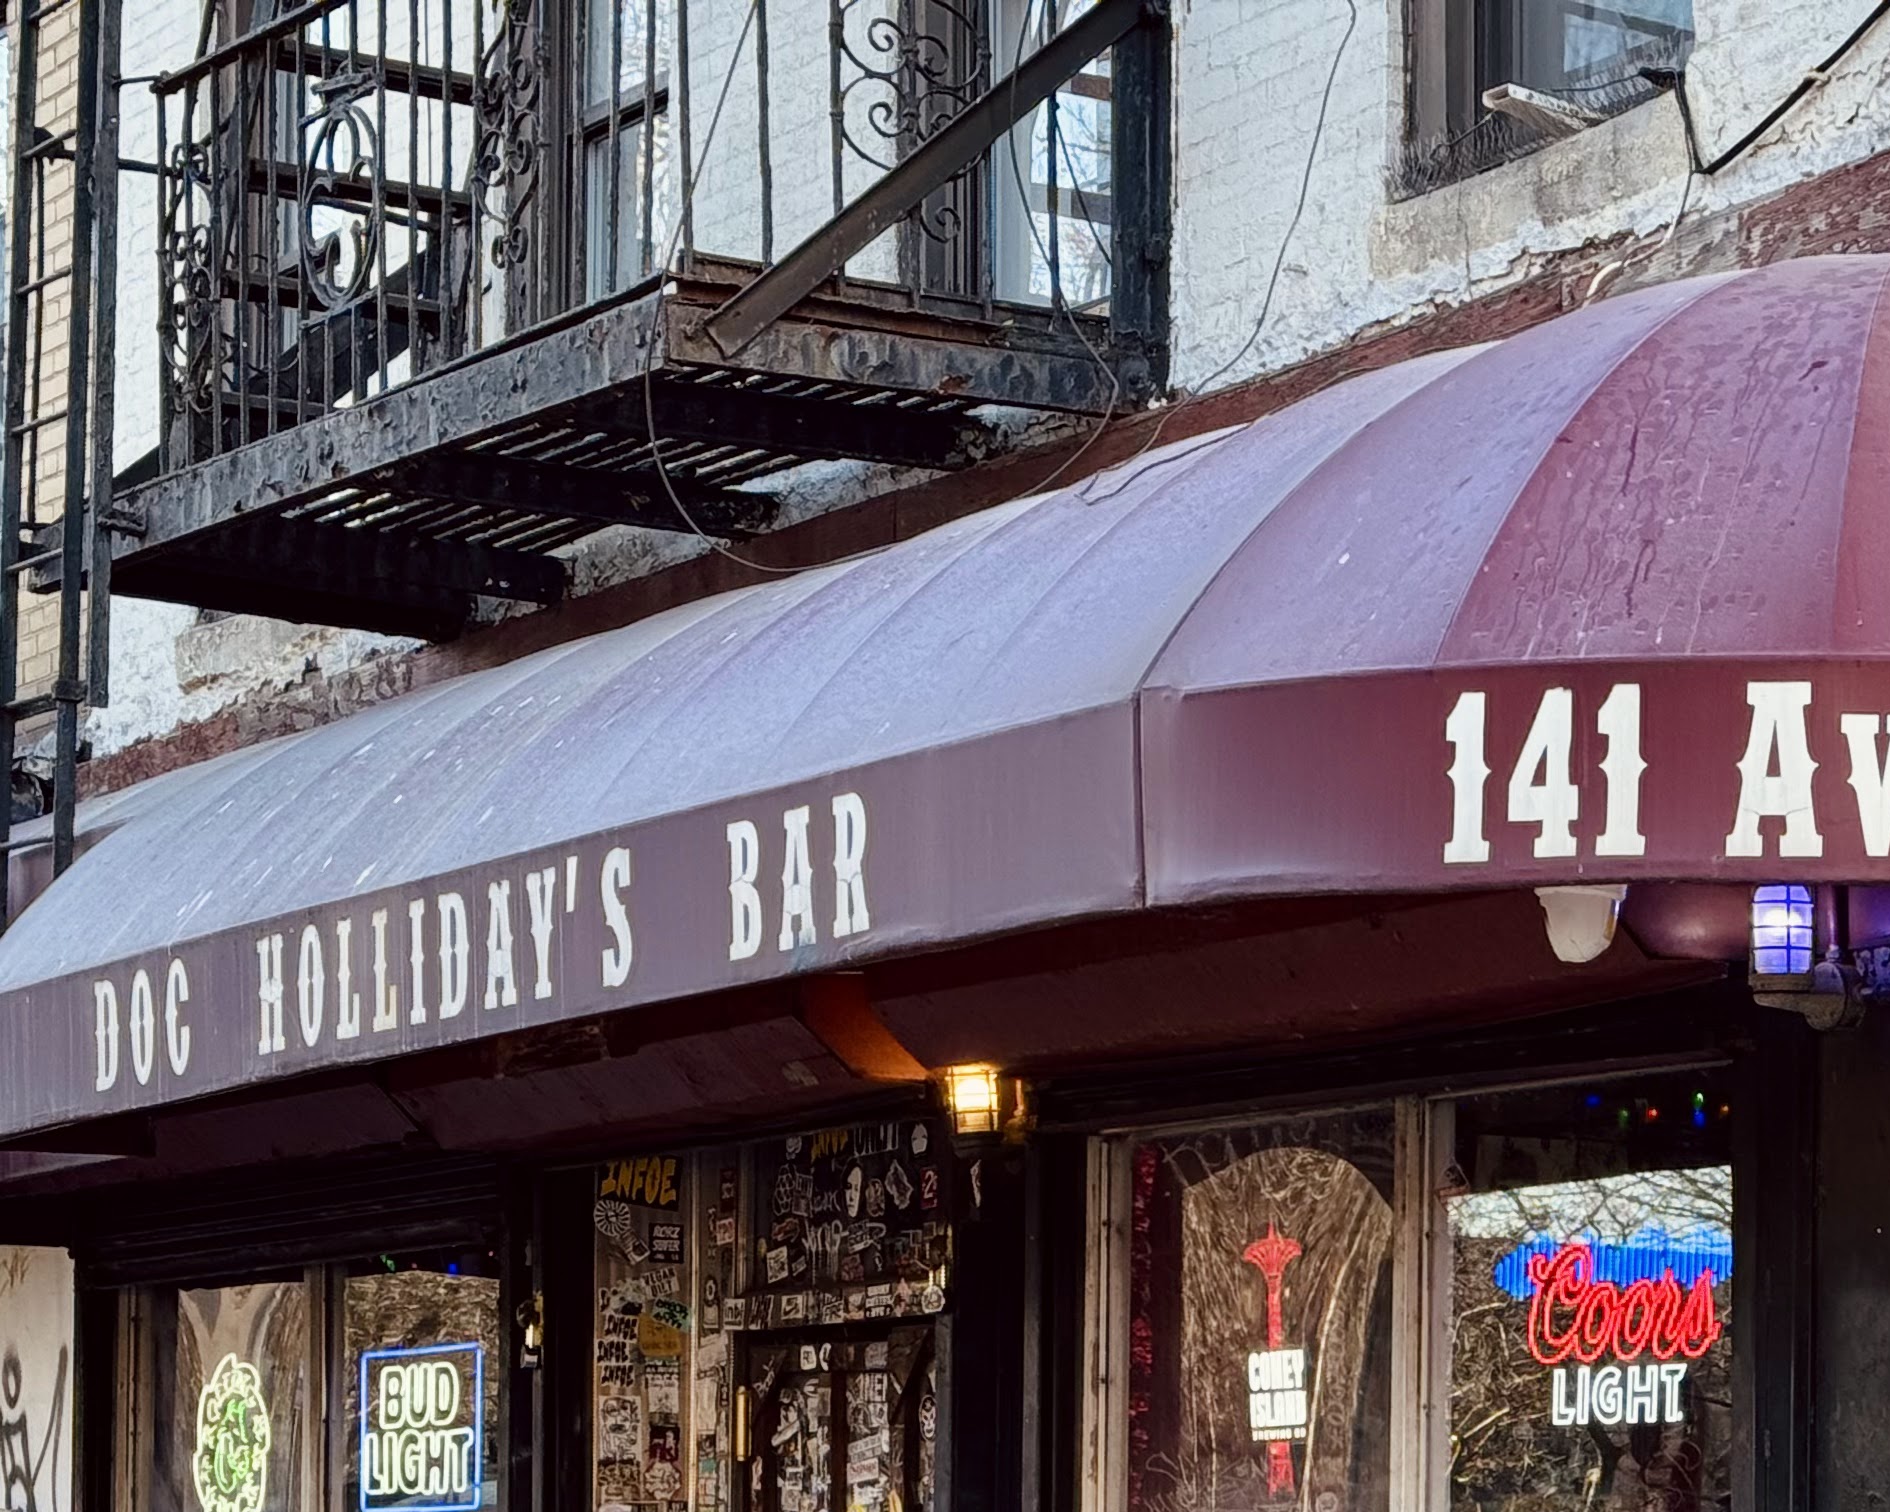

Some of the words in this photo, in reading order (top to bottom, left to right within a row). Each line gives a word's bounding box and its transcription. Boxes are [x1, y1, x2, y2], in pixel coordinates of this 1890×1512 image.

[1443, 683, 1648, 864] 141
[93, 956, 192, 1093] DOC
[256, 855, 632, 1056] HOLLIDAY'S
[726, 791, 870, 962] BAR
[1527, 1242, 1722, 1365] Coors
[379, 1361, 459, 1430] BUD
[1552, 1363, 1687, 1427] LIGHT
[364, 1426, 474, 1496] LIGHT
